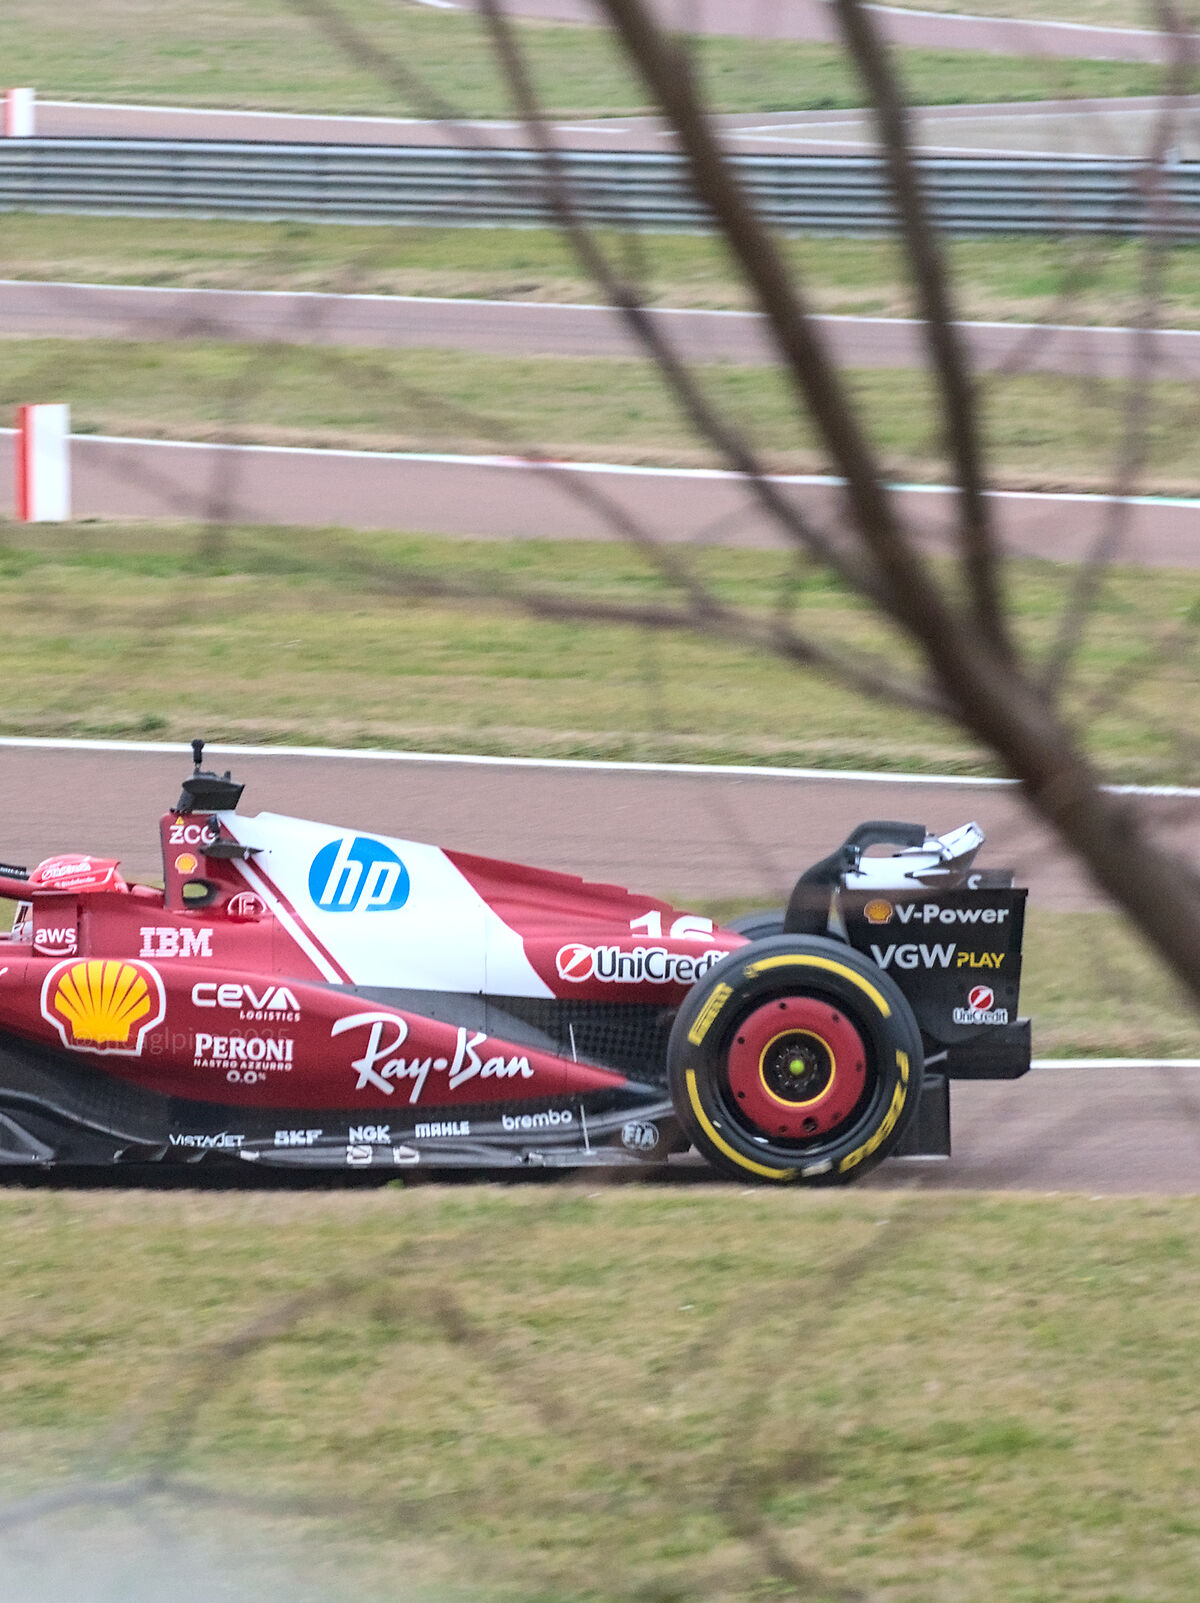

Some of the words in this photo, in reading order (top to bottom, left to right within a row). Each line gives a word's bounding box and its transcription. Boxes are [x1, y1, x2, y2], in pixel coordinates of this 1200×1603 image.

[319, 836, 402, 911] hp
[895, 903, 1010, 924] V-Power
[35, 928, 76, 944] aws
[139, 927, 213, 957] IBM
[870, 943, 957, 969] VGW
[957, 952, 1006, 969] PLAY
[239, 1011, 300, 1023] LOGISTICS
[953, 1008, 1009, 1025] UniCredit
[194, 1033, 294, 1061] PERONI
[193, 1058, 238, 1069] NASTRO
[240, 1060, 293, 1072] AZZURRO
[415, 1120, 470, 1138] MAHLE
[502, 1109, 572, 1131] brembo
[274, 1129, 322, 1146] SKF
[349, 1124, 391, 1144] NGK
